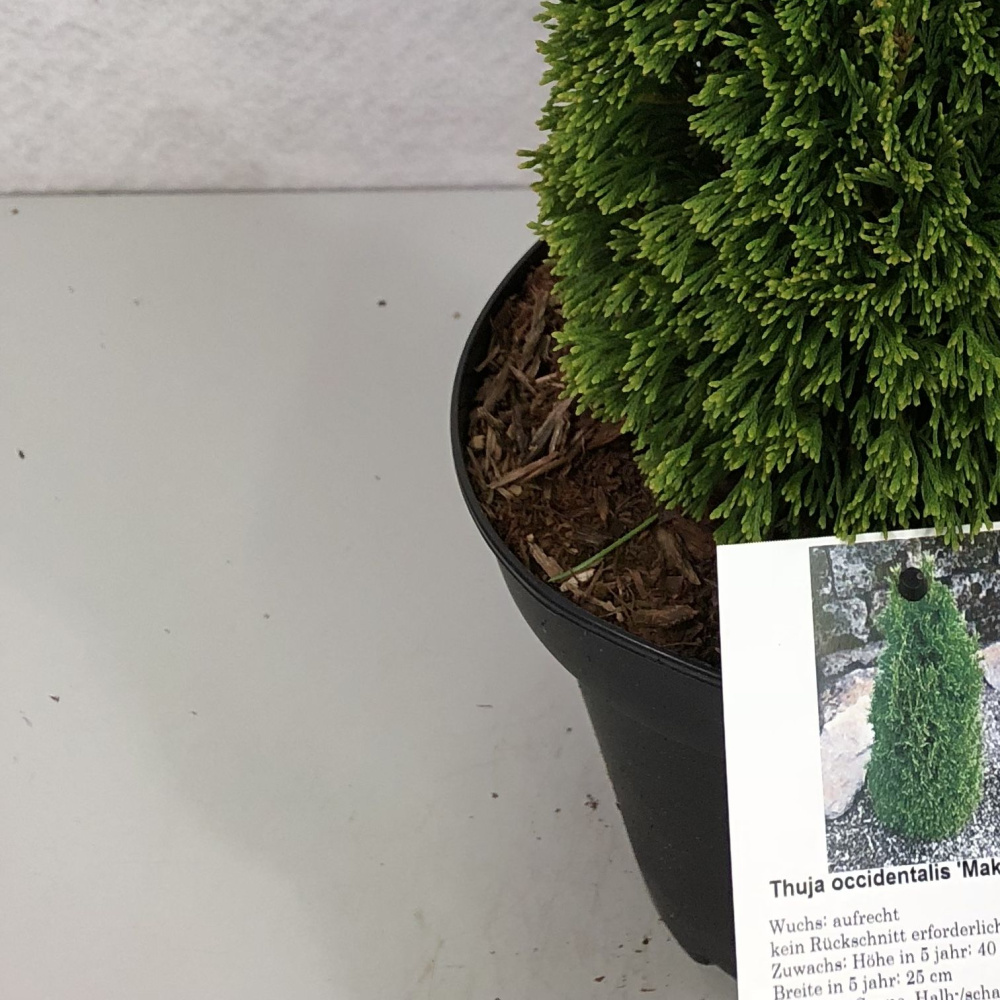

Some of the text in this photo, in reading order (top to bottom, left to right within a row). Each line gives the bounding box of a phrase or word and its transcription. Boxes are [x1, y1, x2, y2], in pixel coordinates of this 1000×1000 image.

[769, 876, 825, 899] Thuja
[832, 863, 951, 890] occidentalis
[769, 907, 900, 935] Wuchs: aufrecht
[770, 940, 805, 957] kein
[810, 929, 907, 952] Rückschnitt
[772, 957, 847, 979] Zuwachs:
[853, 951, 894, 969] Höhe
[900, 950, 915, 964] in
[921, 947, 929, 962] 5
[934, 944, 972, 964] jahr:
[978, 941, 996, 956] 40
[773, 970, 952, 1000] Breite in 5 jahr: 25 cm
